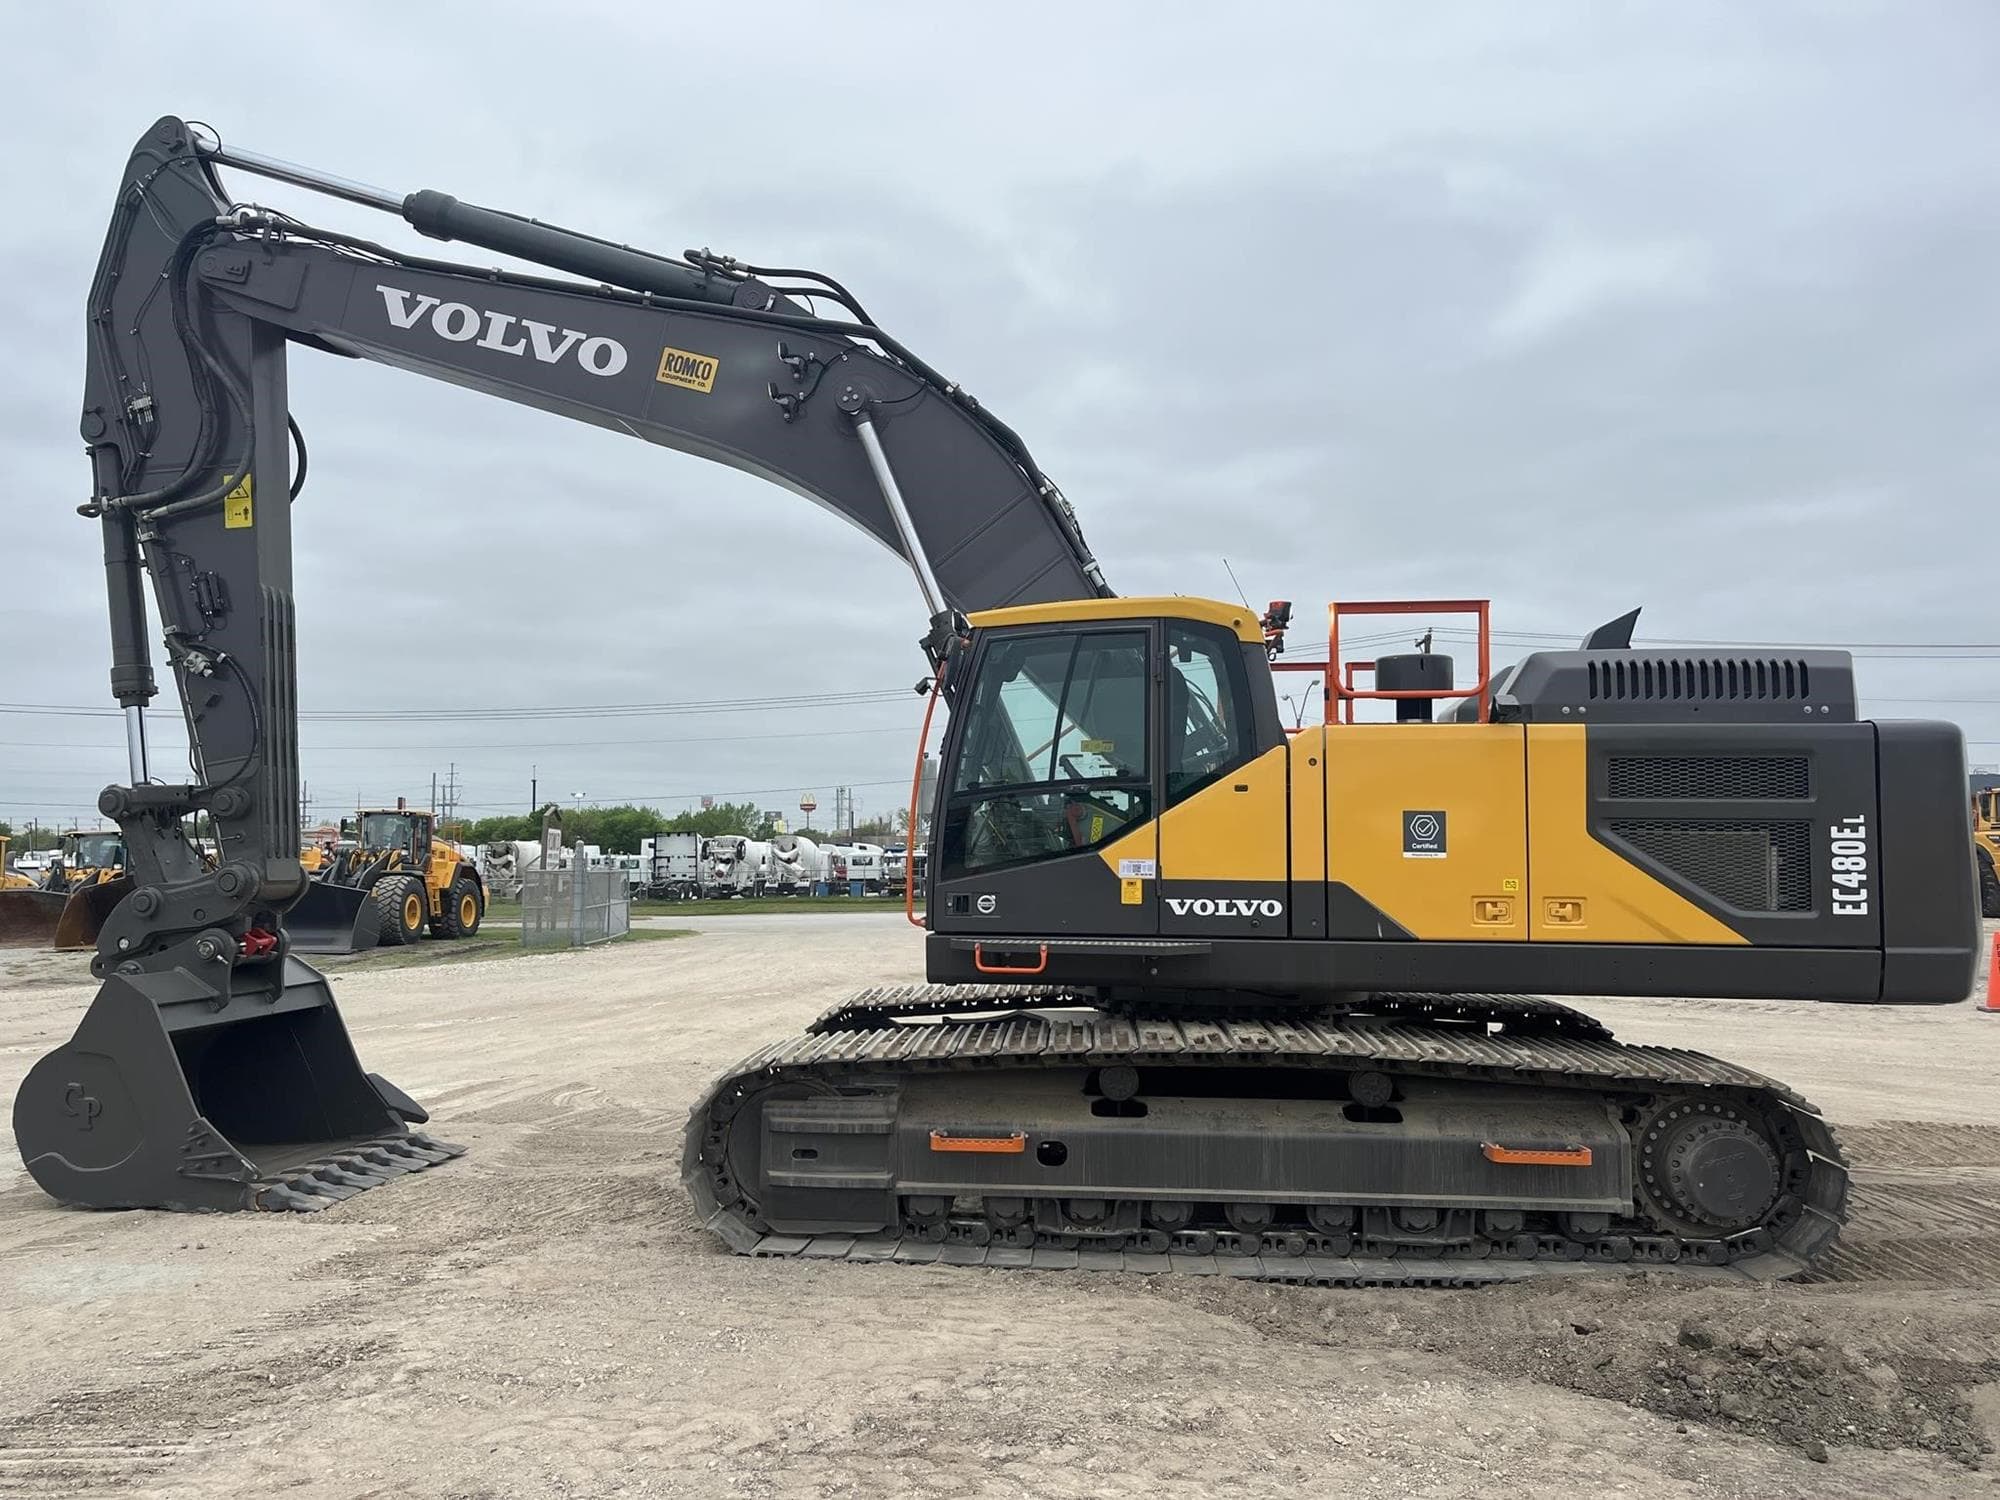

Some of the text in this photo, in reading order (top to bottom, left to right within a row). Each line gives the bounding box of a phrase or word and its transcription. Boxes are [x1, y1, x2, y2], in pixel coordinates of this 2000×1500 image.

[376, 285, 628, 376] VOLVO
[664, 353, 712, 380] ROMCO
[662, 372, 697, 384] EQUIPMENT
[1165, 899, 1283, 917] VOLVO
